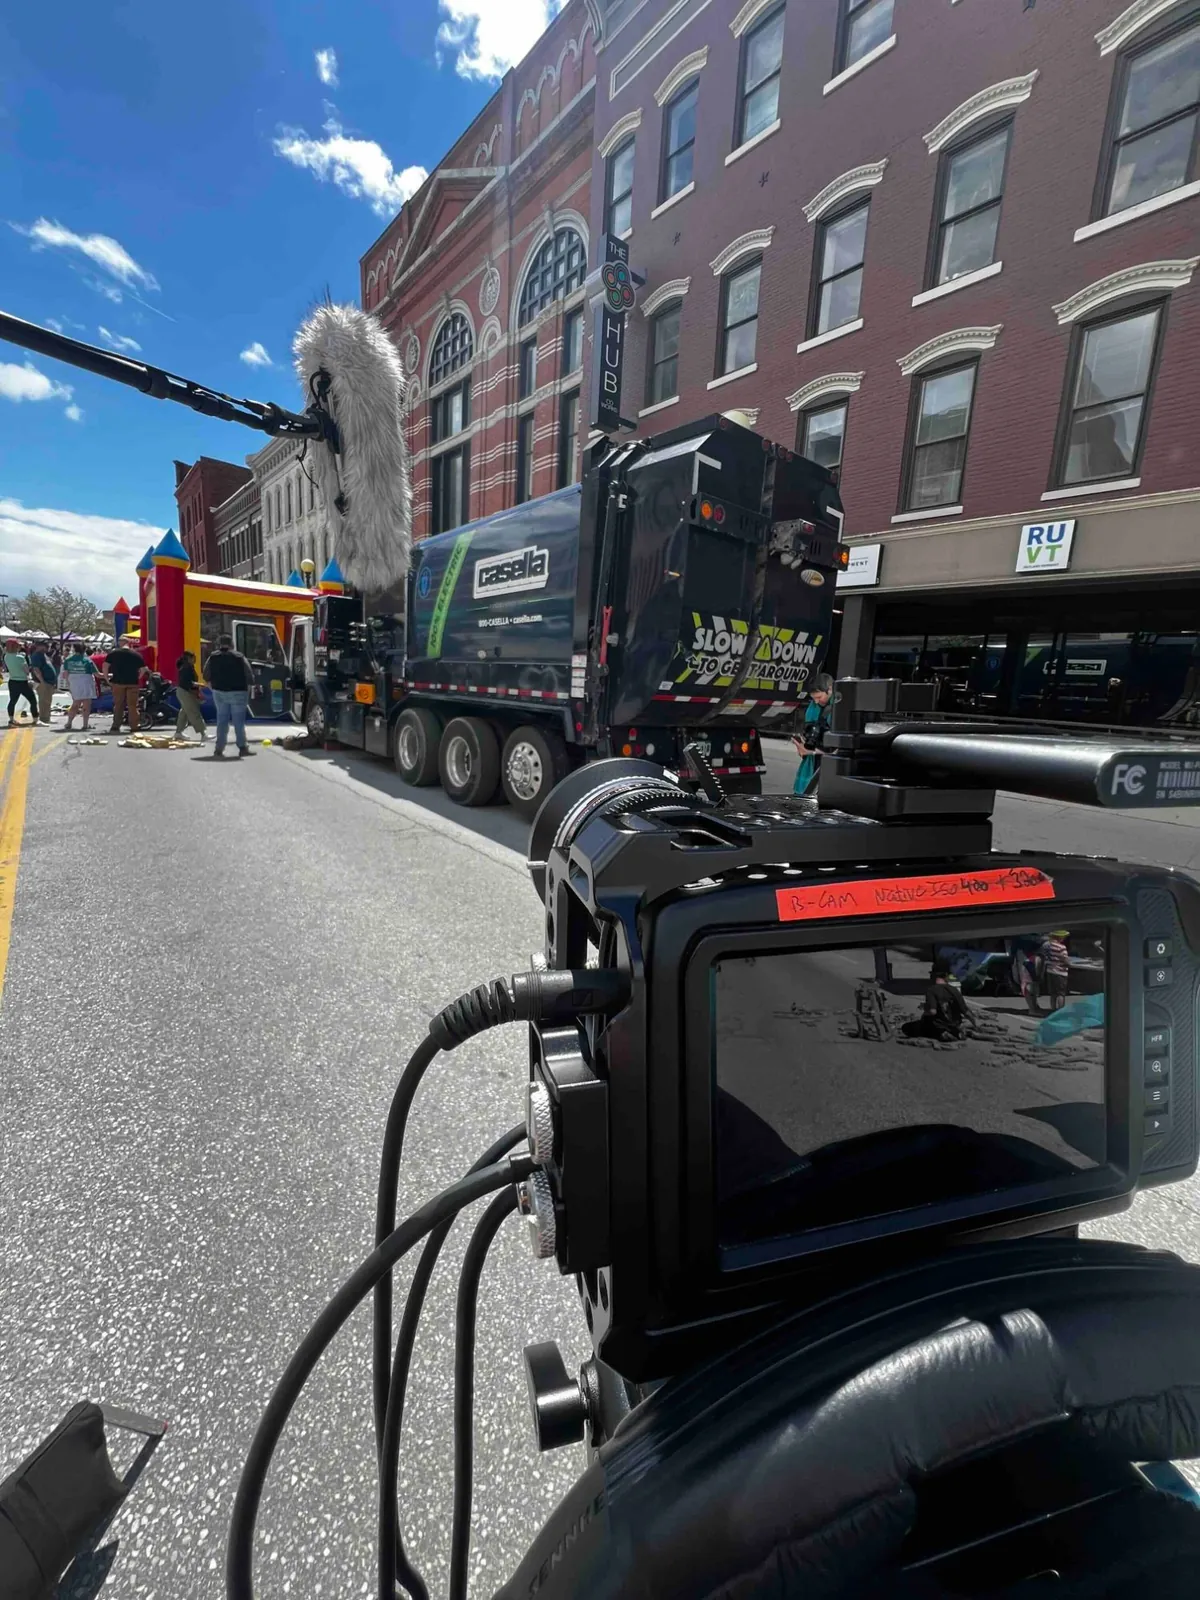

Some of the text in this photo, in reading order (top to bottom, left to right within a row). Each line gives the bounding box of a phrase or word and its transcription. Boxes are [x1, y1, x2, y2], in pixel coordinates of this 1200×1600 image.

[609, 240, 627, 261] THE
[604, 318, 620, 393] HUB
[1027, 523, 1067, 546] RU
[477, 549, 548, 589] casella
[1026, 544, 1063, 564] VT
[438, 543, 463, 613] ELECTRIC
[692, 627, 817, 665] SLOW DOWN
[698, 655, 720, 674] TO
[757, 663, 810, 683] AROUND
